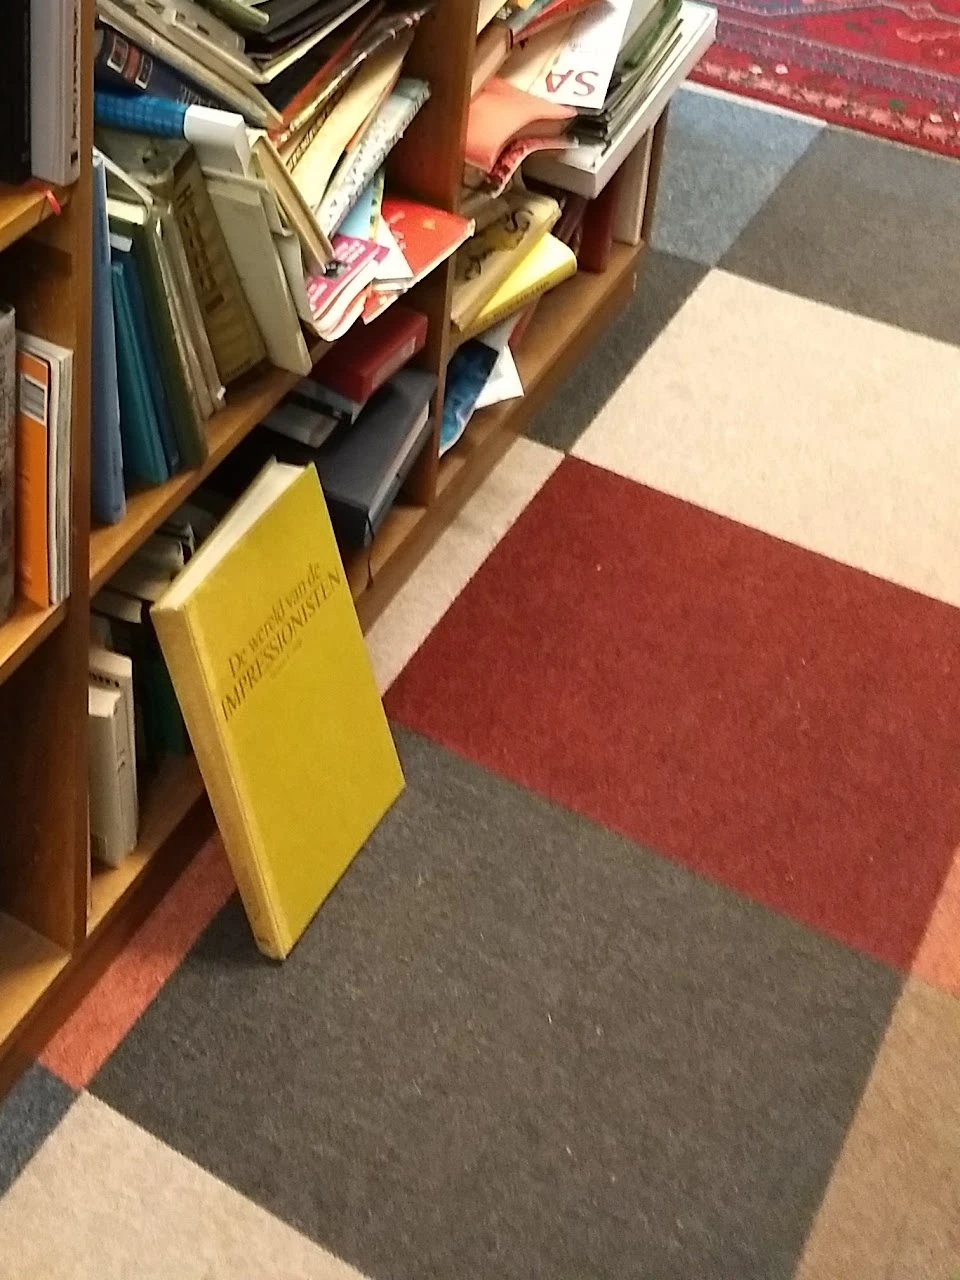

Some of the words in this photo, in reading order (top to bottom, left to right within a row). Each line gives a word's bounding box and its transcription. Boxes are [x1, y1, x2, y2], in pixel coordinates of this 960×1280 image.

[221, 566, 341, 721] IMPRESSIONISTEN
[228, 646, 248, 679] De
[248, 598, 286, 653] wereld
[285, 580, 308, 609] van
[307, 562, 322, 586] de
